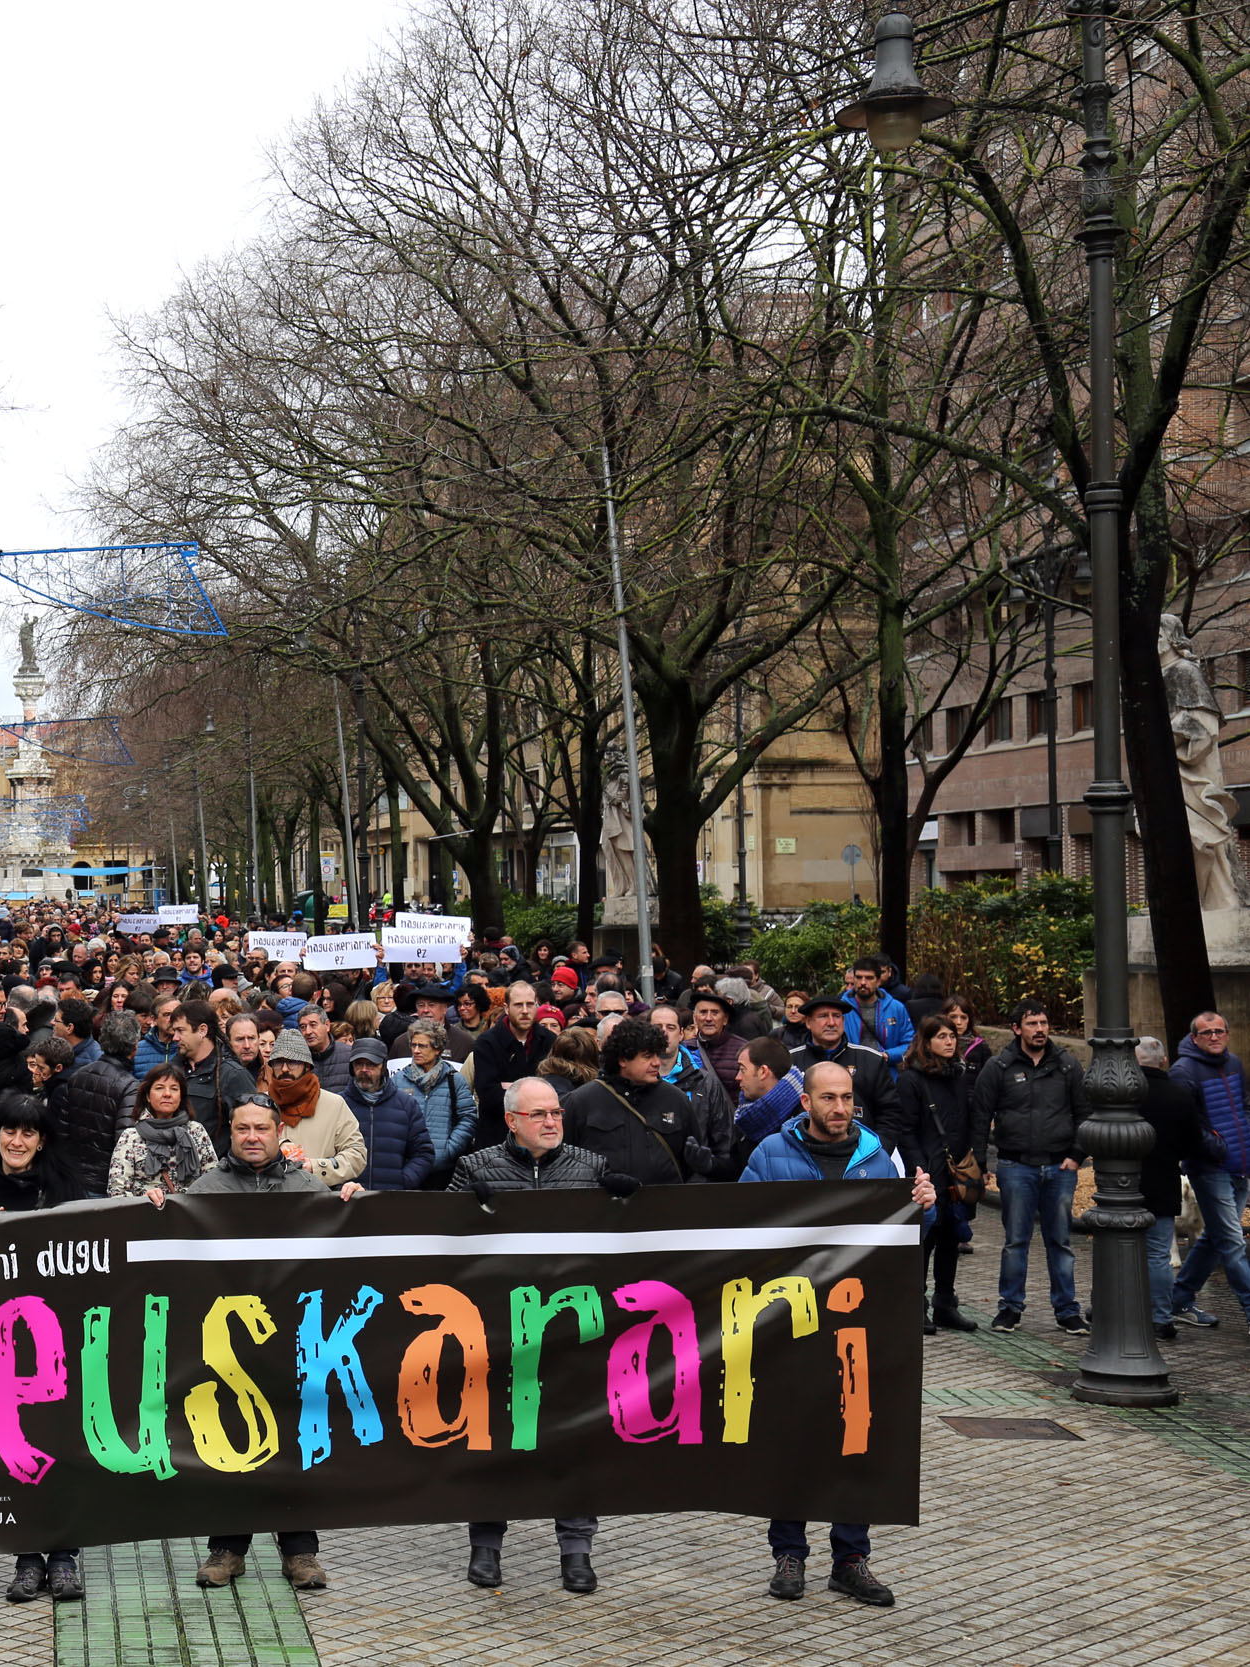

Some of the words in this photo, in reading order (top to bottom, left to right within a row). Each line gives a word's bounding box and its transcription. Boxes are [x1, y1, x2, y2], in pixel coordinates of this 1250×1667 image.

[400, 919, 466, 931] nagusikeriarik
[387, 934, 457, 945] nagusikeriarik
[306, 939, 373, 954] nagusikeriarik
[276, 949, 284, 958] ez
[416, 947, 427, 958] ez
[334, 954, 344, 965] ez
[36, 1238, 111, 1278] dugu
